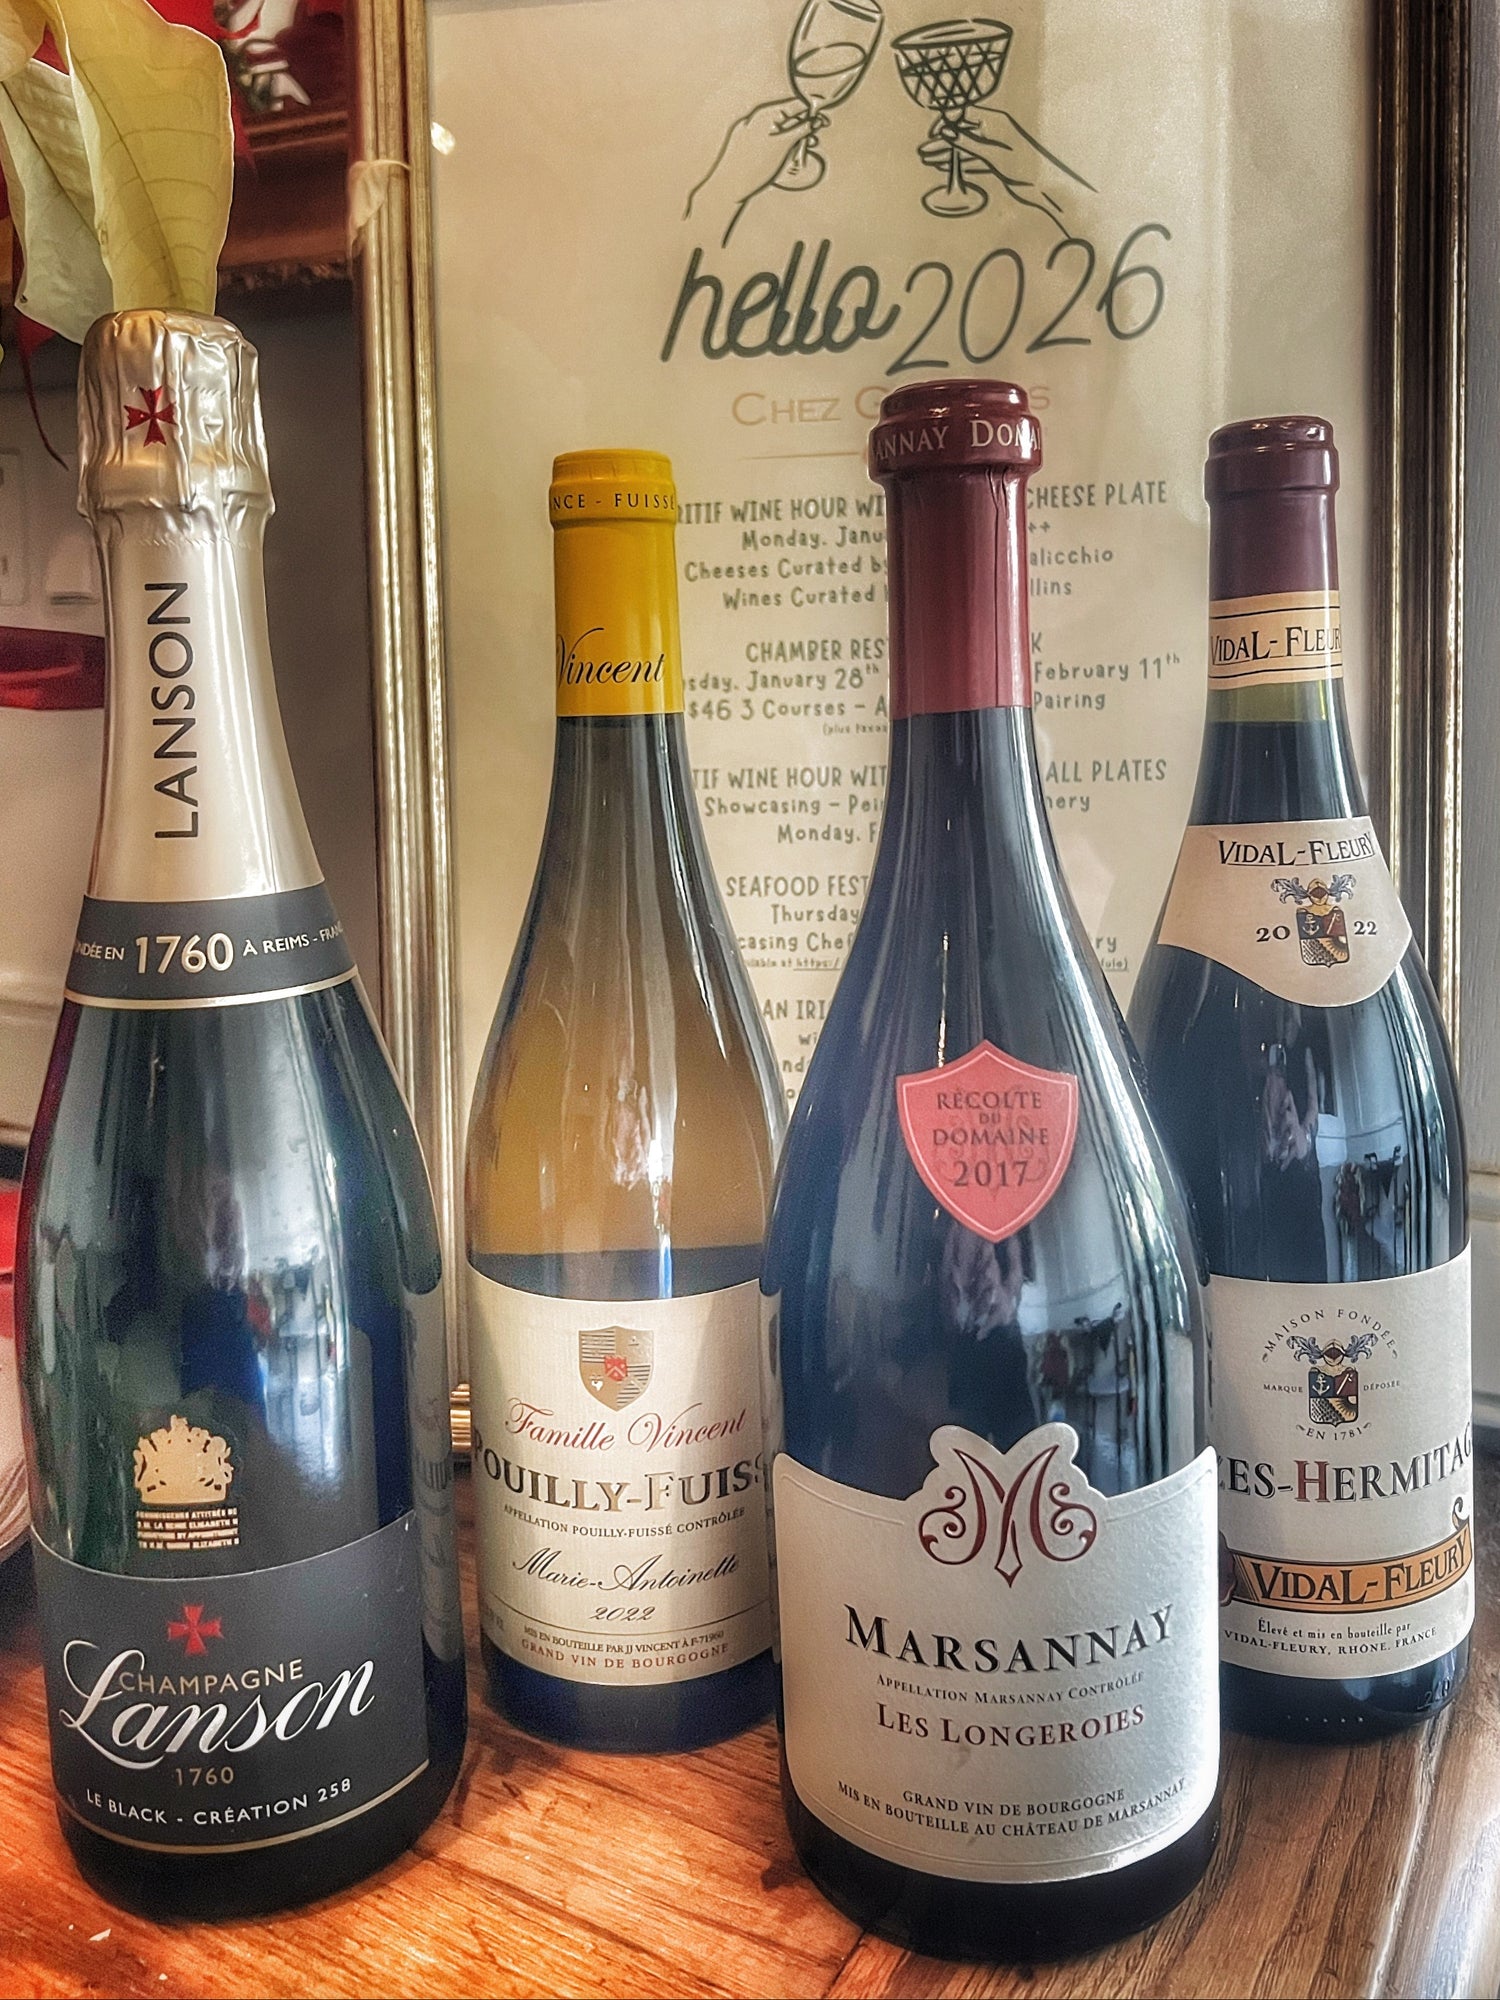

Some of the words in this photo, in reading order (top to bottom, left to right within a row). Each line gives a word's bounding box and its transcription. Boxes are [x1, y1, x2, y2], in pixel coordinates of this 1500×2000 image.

[662, 240, 900, 361] hello
[886, 224, 1171, 376] 2026
[731, 499, 782, 523] WINE
[791, 497, 847, 520] HOUR
[1105, 481, 1168, 506] PLATE
[836, 526, 886, 548] Janu
[684, 561, 769, 582] Cheeses
[777, 555, 862, 579] Curated
[722, 588, 782, 610] Wines
[790, 584, 875, 607] Curated
[557, 627, 666, 687] Vincent
[746, 639, 842, 662] CHAMBER
[850, 638, 887, 660] RES
[747, 670, 826, 692] January
[835, 664, 879, 690] 28th
[1034, 661, 1129, 684] February
[1139, 652, 1180, 680] 11th
[144, 582, 198, 838] LANSON
[688, 699, 731, 721] $46
[740, 698, 755, 720] 3
[762, 699, 845, 719] Courses
[1034, 691, 1105, 713] Pairing
[728, 767, 778, 789] WINE
[786, 765, 842, 788] HOUR
[1092, 758, 1168, 782] PLATES
[704, 795, 821, 817] Showcasing
[726, 876, 819, 897] SEAFOOD
[1256, 925, 1290, 942] 20
[1354, 920, 1378, 936] 22
[104, 945, 125, 960] EN
[135, 932, 235, 974] 1760
[263, 933, 310, 954] REIMS
[937, 1087, 1042, 1110] RÉCOLTE
[979, 1112, 1000, 1124] DU
[933, 1127, 1049, 1146] DOMAINE
[953, 1160, 1029, 1187] 2017
[1264, 1309, 1325, 1353] MAISON
[1337, 1308, 1396, 1349] FONDÉE
[505, 1397, 616, 1451] Famille
[627, 1402, 747, 1453] Vincent
[1334, 1426, 1362, 1441] 1781
[503, 1503, 568, 1533] APPELLATION
[512, 1547, 740, 1592] Marie-Antoinette
[1250, 1528, 1468, 1605] VIDAL-FLEURY
[589, 1605, 656, 1622] 2022
[1258, 1616, 1288, 1635] Élevé
[1307, 1628, 1326, 1639] mis
[1330, 1631, 1343, 1640] en
[1347, 1622, 1392, 1639] bouteille
[1395, 1622, 1411, 1637] par
[552, 1636, 604, 1653] BOUTEILLE
[606, 1643, 624, 1654] PAR
[843, 1602, 1174, 1674] MARSANNAY
[1395, 1626, 1437, 1648] FRANCE
[522, 1638, 565, 1662] GRAND
[571, 1653, 597, 1668] VIN
[604, 1658, 624, 1669] DE
[632, 1642, 729, 1669] BOURGOGNE
[118, 1657, 304, 1696] CHAMPAGNE
[875, 1673, 968, 1701] APPELLATION
[974, 1689, 1064, 1705] MARSANNAY
[59, 1639, 375, 1770] Lanson
[876, 1702, 930, 1738] LES
[941, 1703, 1146, 1747] LONGEROIES
[173, 1766, 235, 1786] 1760
[86, 1788, 103, 1808] LE
[108, 1798, 168, 1825] BLACK
[193, 1794, 309, 1825] CRÉATION
[317, 1777, 352, 1803] 258
[837, 1780, 860, 1801] MIS
[862, 1793, 882, 1811] EN
[884, 1804, 970, 1835] BOUTEILLE
[974, 1822, 996, 1836] AU
[1001, 1818, 1079, 1837] CHÂTEAU
[1083, 1813, 1103, 1830] DE
[1107, 1777, 1187, 1825] MARSANNAY
[902, 1789, 960, 1812] GRAND
[964, 1801, 994, 1816] VIN
[1000, 1803, 1022, 1817] DE
[1026, 1788, 1125, 1817] BOURGOGNE
